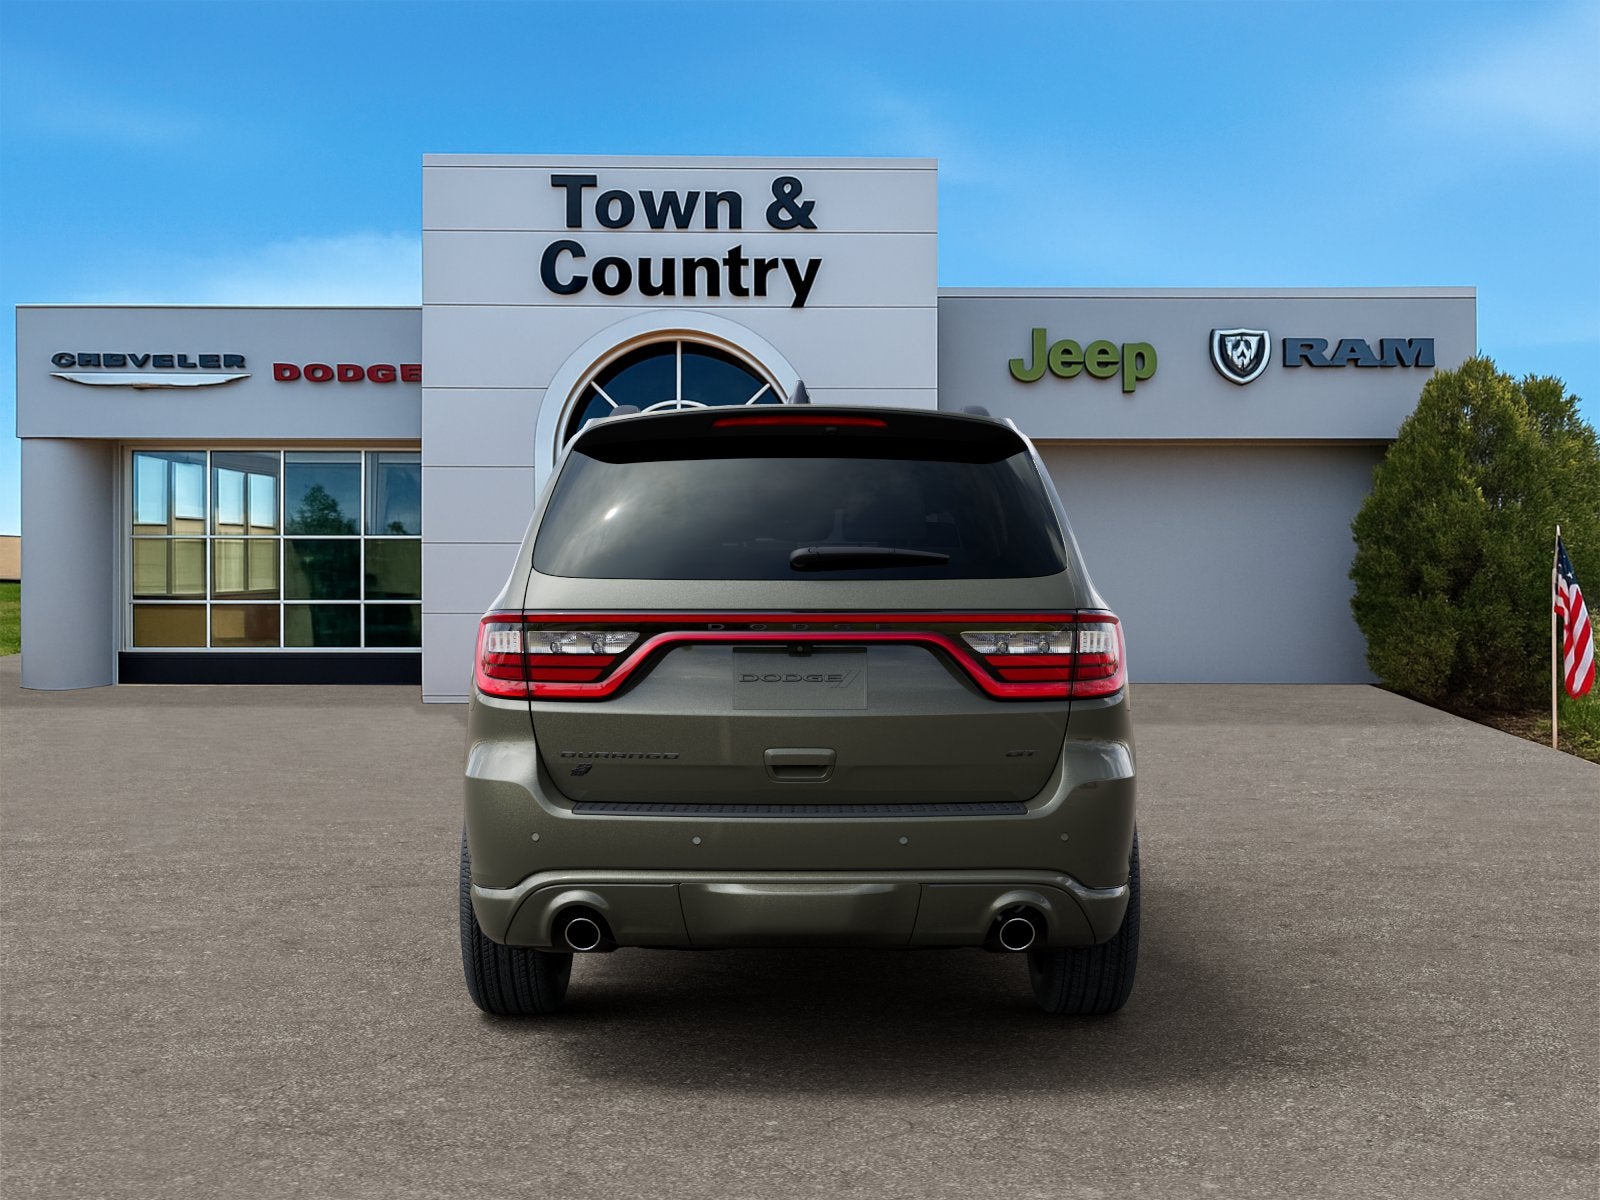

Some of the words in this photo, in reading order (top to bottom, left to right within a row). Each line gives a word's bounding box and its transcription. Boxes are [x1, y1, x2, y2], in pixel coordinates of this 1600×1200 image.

[550, 174, 743, 229] Town
[765, 176, 818, 231] &
[540, 239, 823, 308] Country
[1008, 327, 1158, 392] Jeep
[1282, 337, 1436, 368] RAM
[273, 362, 422, 383] DODGE
[707, 623, 892, 631] DODGE
[738, 673, 844, 684] DODGE
[560, 751, 680, 760] DURANGO
